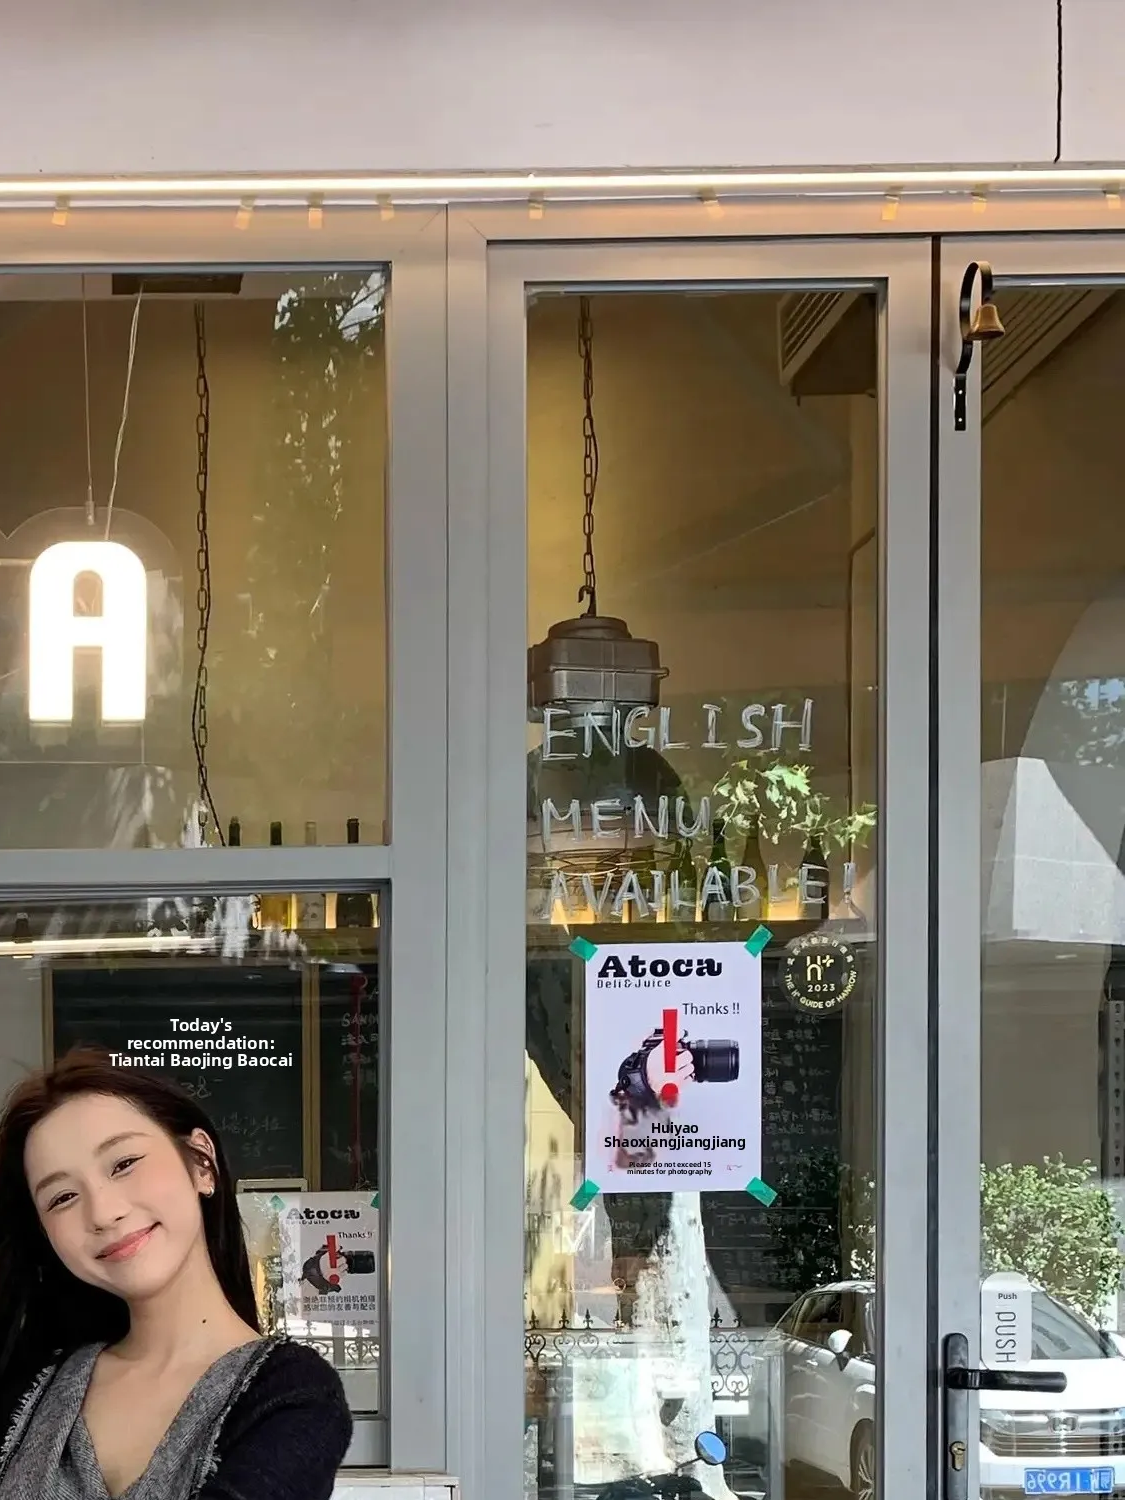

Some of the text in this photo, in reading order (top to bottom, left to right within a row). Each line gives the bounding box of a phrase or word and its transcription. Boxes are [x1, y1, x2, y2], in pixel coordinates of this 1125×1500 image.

[542, 697, 814, 760] ENGLISH
[542, 796, 710, 841] MENU
[597, 954, 723, 978] Atoca
[784, 973, 795, 990] THE
[799, 996, 824, 1009] GUIDE
[824, 998, 836, 1008] OF
[835, 970, 858, 1003] HANKOW
[807, 983, 836, 992] 2023
[682, 1003, 729, 1016] Thanks
[286, 1207, 361, 1220] Atoca
[338, 1231, 366, 1239] Thanks
[997, 1292, 1018, 1300] Push
[995, 1311, 1017, 1363] PUSH
